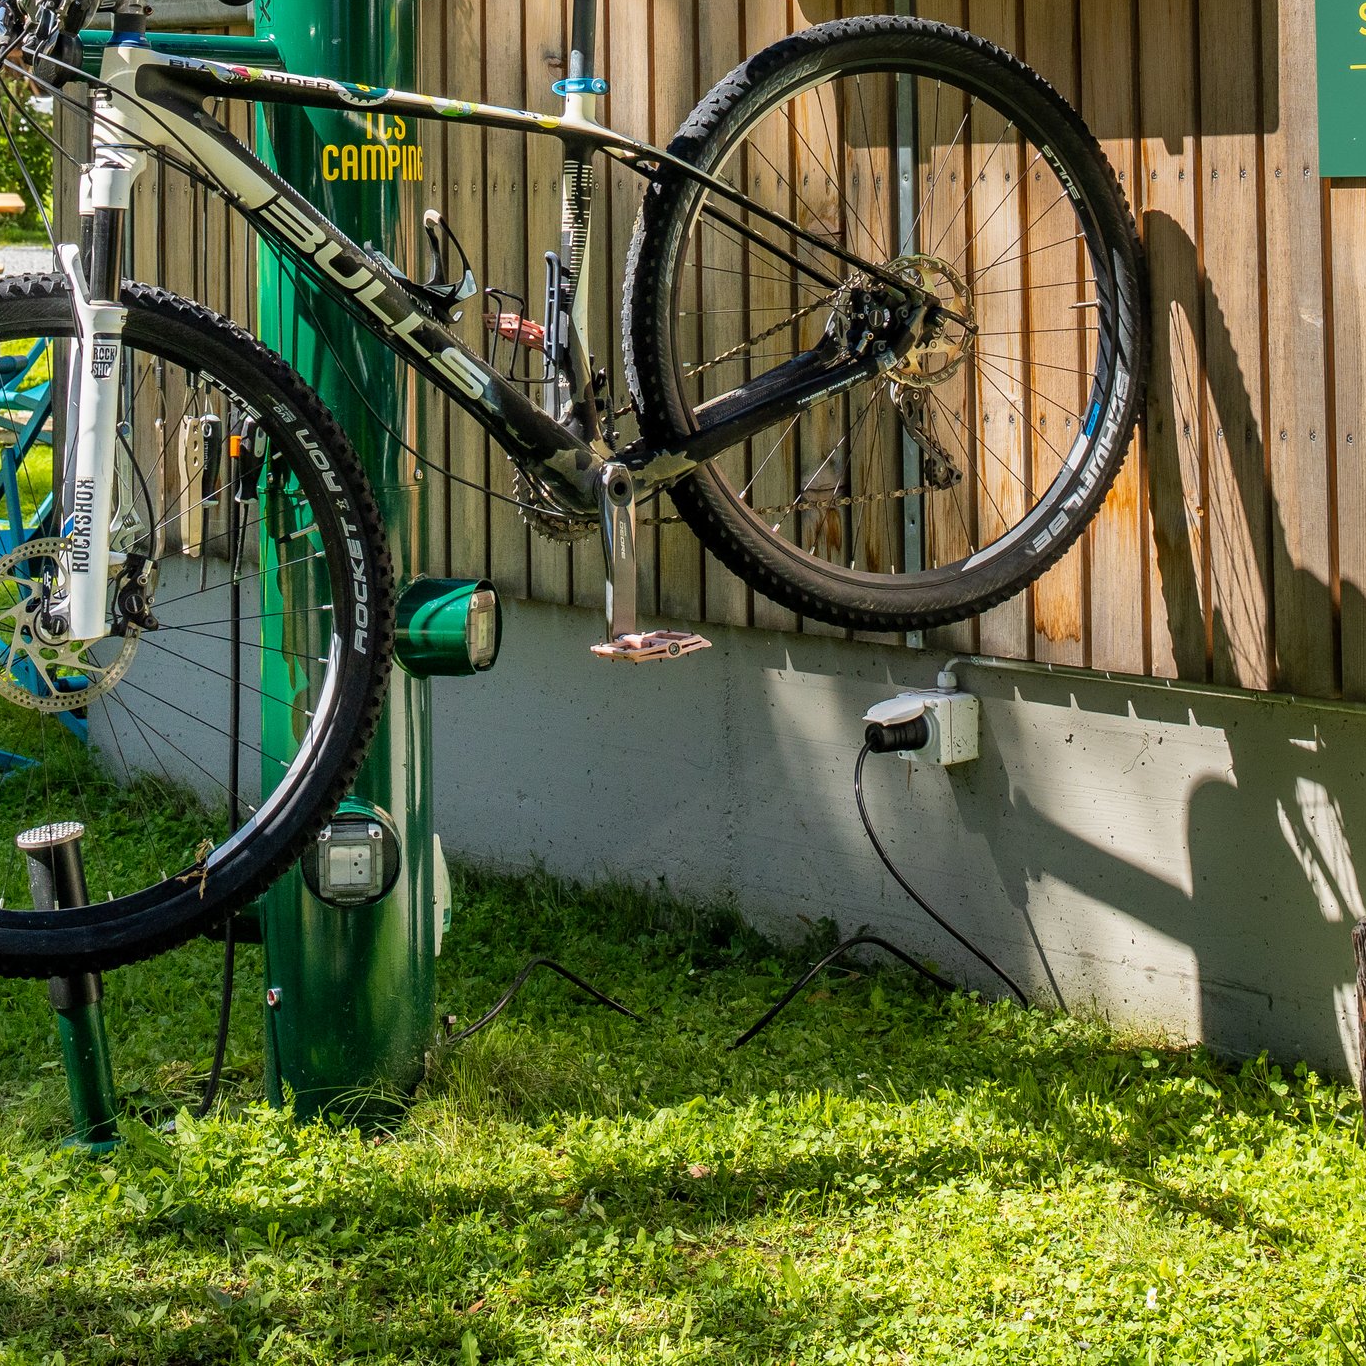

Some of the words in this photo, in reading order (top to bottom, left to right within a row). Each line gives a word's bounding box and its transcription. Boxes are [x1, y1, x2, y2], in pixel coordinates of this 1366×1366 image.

[322, 144, 423, 181] CAMPING
[1041, 144, 1081, 200] BULLS
[258, 195, 491, 400] BULLS
[92, 362, 111, 376] SHO
[199, 370, 262, 420] BULLS
[295, 428, 342, 492] RON
[1032, 370, 1130, 553] SCHWALBE
[71, 475, 95, 573] ROCKSHOX
[339, 516, 368, 655] ROCKET
